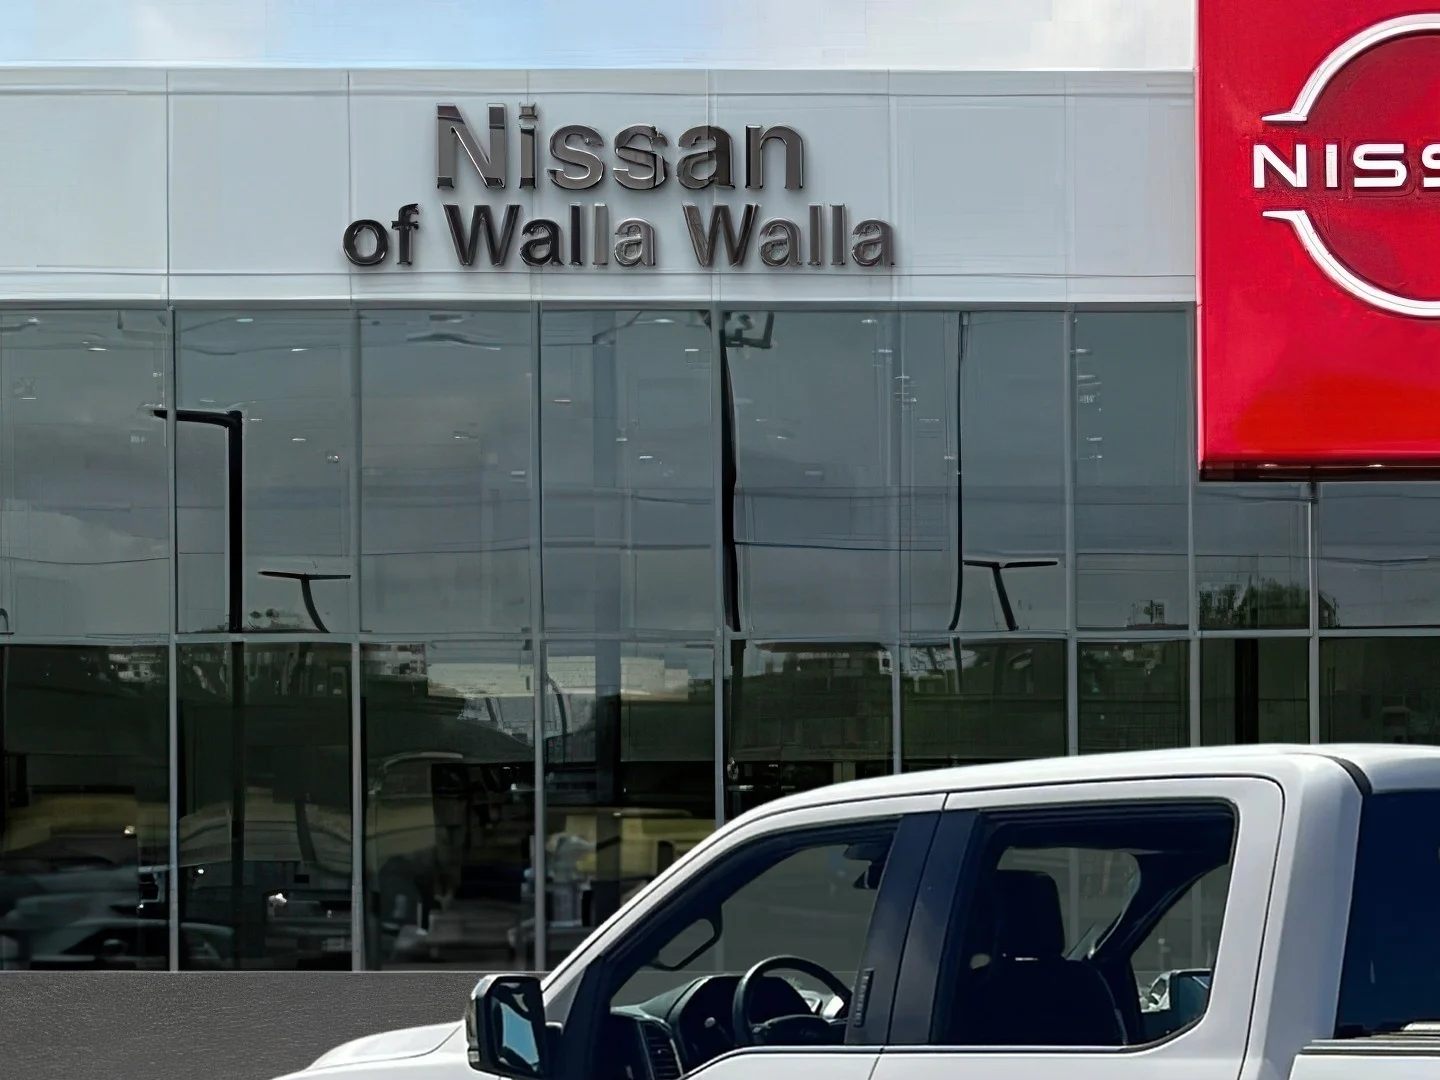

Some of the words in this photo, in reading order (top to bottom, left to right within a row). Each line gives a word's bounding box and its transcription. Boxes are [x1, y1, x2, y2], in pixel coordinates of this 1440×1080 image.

[436, 102, 804, 190] Nissan
[342, 203, 420, 266] of
[443, 203, 657, 266] Walla
[681, 203, 896, 266] Walla
